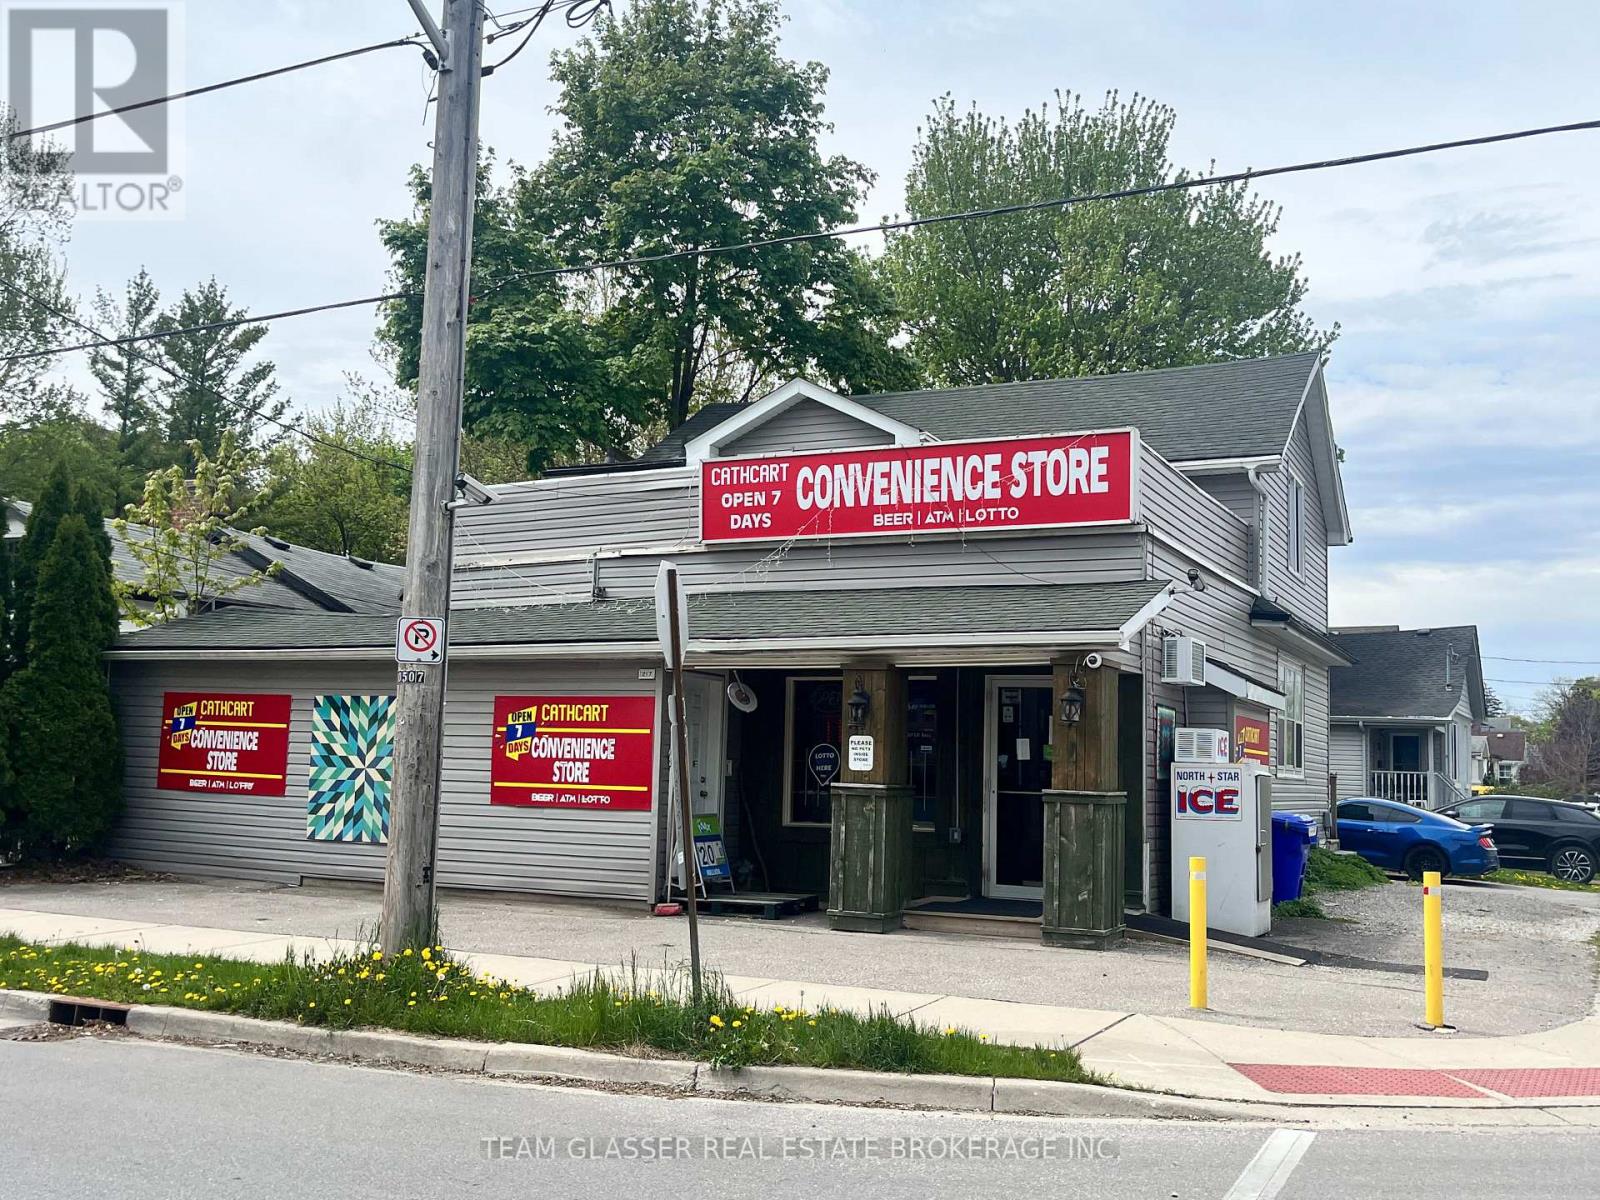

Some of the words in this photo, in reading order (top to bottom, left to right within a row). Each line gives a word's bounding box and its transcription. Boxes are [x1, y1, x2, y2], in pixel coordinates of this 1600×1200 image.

[711, 463, 789, 486] CATHCART
[796, 453, 1002, 510] CONVENIENCE
[1009, 446, 1109, 499] STORE
[721, 491, 766, 508] OPEN
[771, 491, 782, 506] 7
[730, 512, 772, 530] DAYS
[873, 512, 914, 527] BEER
[925, 510, 955, 524] ATM
[965, 507, 1020, 521] LOTTO
[176, 705, 194, 716] OPEN
[200, 700, 255, 717] CATHCART
[511, 710, 533, 722] OPEN
[541, 704, 609, 722] CATHCART
[179, 718, 186, 730] 7
[515, 725, 523, 737] 7
[173, 732, 189, 744] DAYS
[190, 728, 259, 751] CONVENIENCE
[508, 740, 529, 753] DAYS
[531, 736, 616, 760] CONVENIENCE
[1217, 736, 1228, 757] ICE
[206, 751, 238, 771] STORE
[552, 760, 590, 783] STORE
[1176, 771, 1205, 781] NORTH
[1217, 771, 1240, 781] STAR
[531, 793, 554, 802] BEER
[560, 794, 577, 802] ATM
[581, 795, 611, 804] LOTTO
